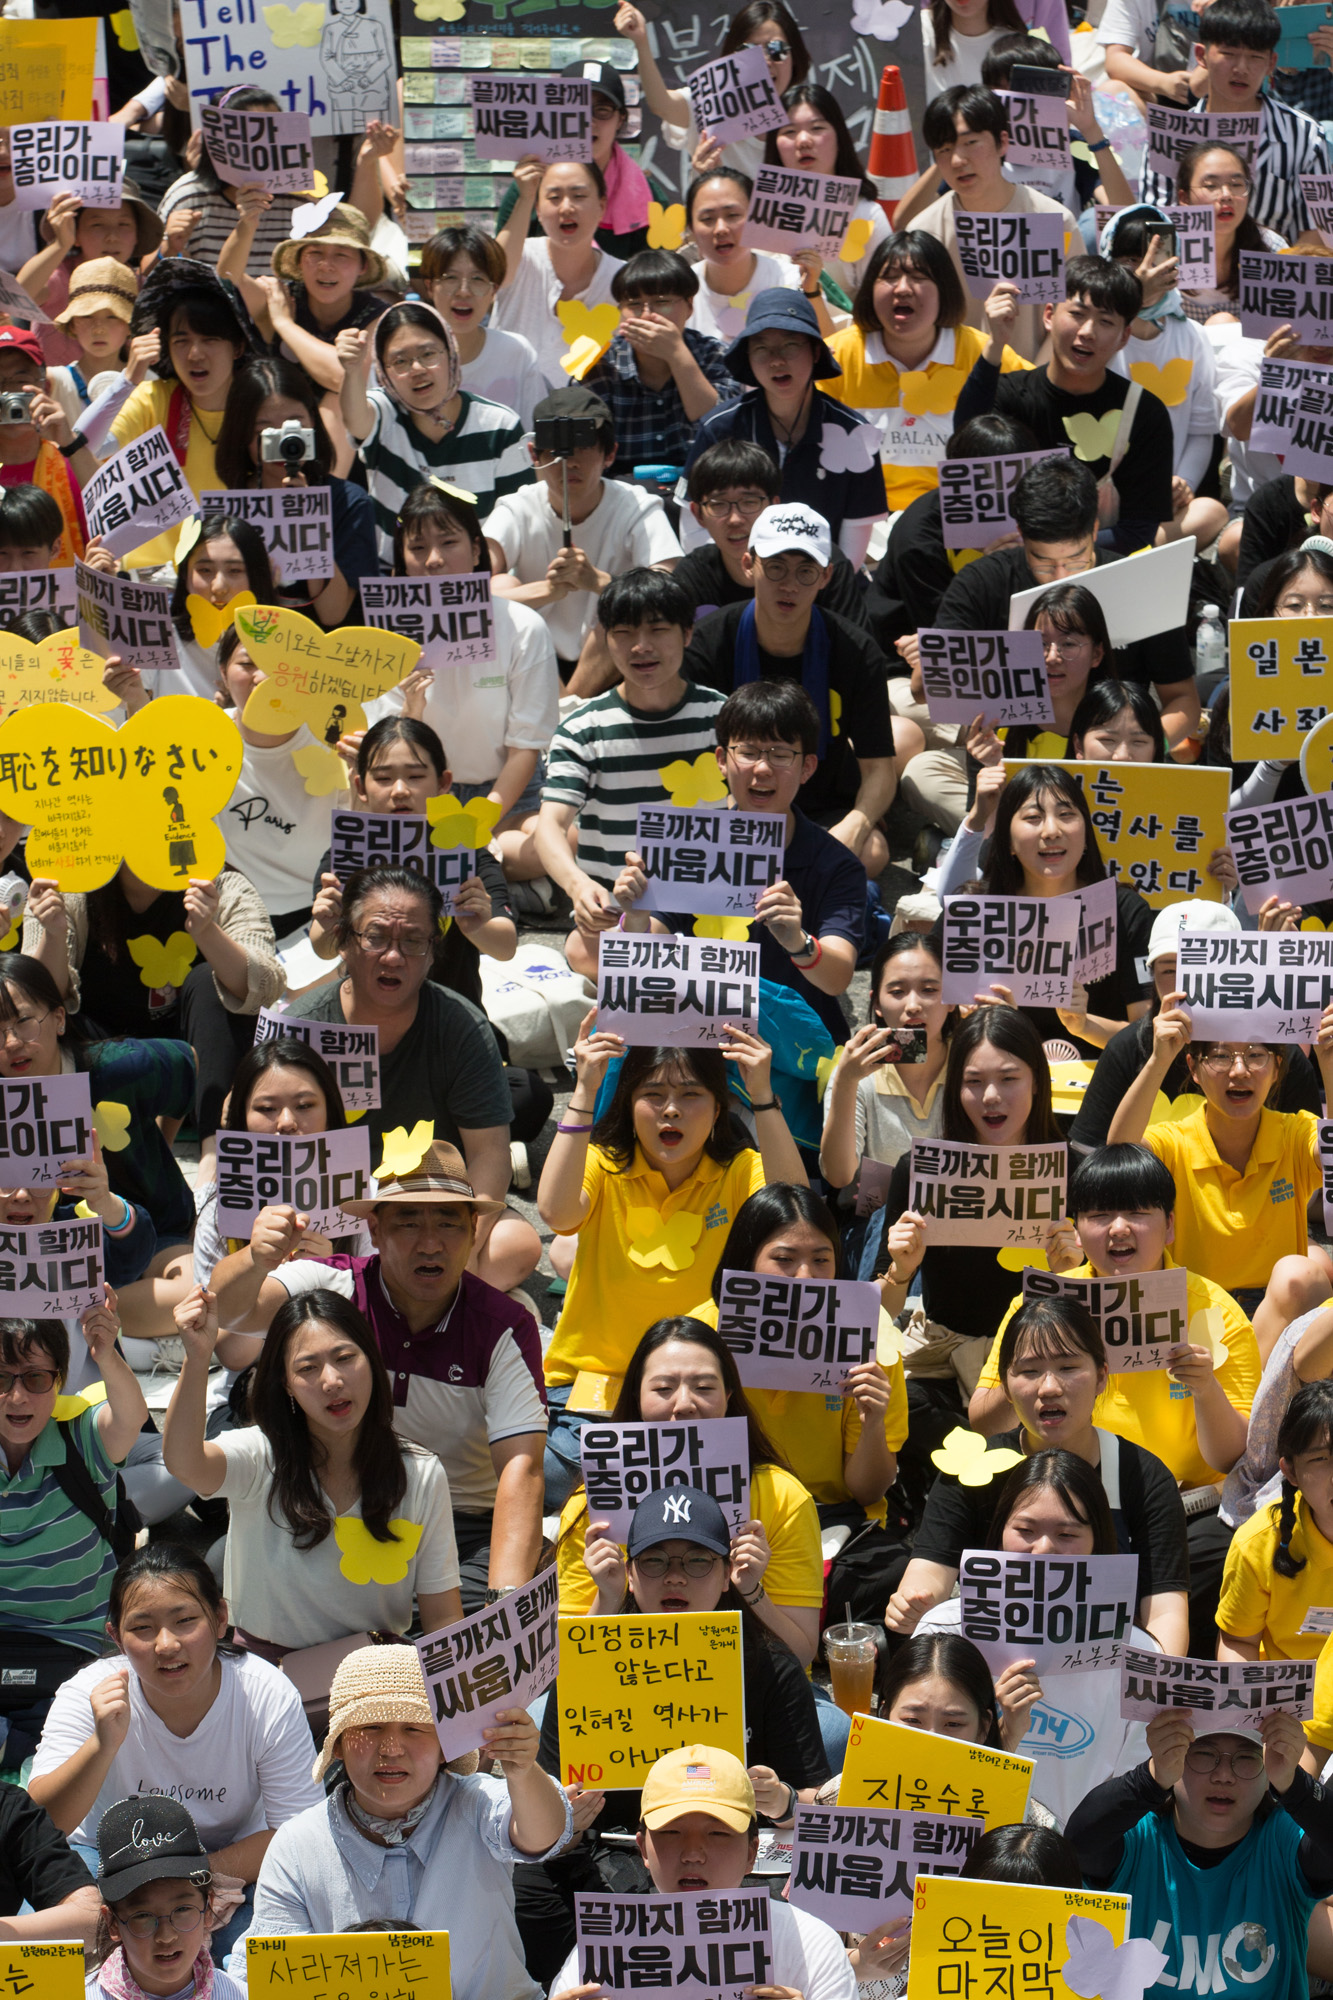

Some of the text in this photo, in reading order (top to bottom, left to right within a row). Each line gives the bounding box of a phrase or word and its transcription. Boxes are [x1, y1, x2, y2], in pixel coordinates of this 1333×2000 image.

[184, 0, 256, 29] Tell
[186, 34, 268, 76] The
[473, 81, 588, 105] 끝까지 함께
[690, 59, 740, 97] 우리가
[201, 108, 278, 144] 우리가
[475, 109, 589, 140] 싸웁시다
[1147, 108, 1260, 138] 끝까지 함께
[12, 126, 92, 157] 우리가
[207, 134, 311, 171] 증인이다
[14, 155, 121, 187] 증인이다
[757, 169, 859, 210] 끝까지 함께
[749, 199, 853, 239] 싸웁시다
[955, 216, 1030, 247] 우리가
[959, 247, 1064, 278] 증인이다
[1241, 257, 1307, 284] 끝까지
[83, 432, 170, 511] 끝까지 함께
[89, 461, 183, 537] 싸웁시다
[201, 491, 329, 519] 끝까지 함께
[285, 554, 332, 574] 김복동
[75, 562, 169, 614] 끝까지 함께
[362, 577, 490, 609] 끝까지 함께
[77, 595, 172, 649] 싸웁시다
[127, 652, 178, 668] 김복동
[326, 642, 406, 681] 그날까지
[445, 641, 495, 663] 김복동
[920, 632, 1010, 668] 우리가
[923, 664, 1048, 700] 증인이다
[1000, 699, 1052, 721] 김복동
[229, 796, 297, 836] Paris
[639, 811, 783, 849] 끝까지 함께
[164, 831, 197, 842] Evidence
[643, 843, 783, 888] 싸웁시다
[945, 900, 1049, 940] 우리가
[602, 939, 757, 978] 끝까지 함께
[945, 937, 1073, 977] 증인이다
[1180, 938, 1268, 967] 끝까지
[600, 975, 757, 1020] 싸웁시다
[1022, 979, 1072, 1004] 김복동
[320, 1029, 376, 1057] 함께
[218, 1136, 332, 1178] 우리가
[913, 1144, 1065, 1180] 끝까지 함께
[911, 1180, 1064, 1222] 싸웁시다
[1272, 1190, 1295, 1205] FESTA
[38, 1223, 101, 1256] 함께
[723, 1276, 842, 1324] 우리가
[718, 1314, 875, 1366] 증인이다
[1170, 1390, 1193, 1400] FESTA
[583, 1425, 704, 1470] 우리가
[662, 1494, 692, 1525] NY
[961, 1556, 1092, 1603] 우리가
[419, 1570, 559, 1678] 끝까지 함께
[566, 1621, 740, 1656] 인정하지 남원여고
[961, 1597, 1131, 1646] 증인이다
[709, 1638, 738, 1652] 은가비
[1060, 1644, 1122, 1670] 김복동
[434, 1607, 559, 1725] 싸웁시다
[613, 1658, 715, 1688] 않는다고
[1124, 1648, 1314, 1686] 끝까지 함께
[1124, 1675, 1313, 1712] 싸웁시다
[652, 1700, 730, 1731] 역사가
[566, 1762, 604, 1786] NO
[968, 1748, 1032, 1775] 남원여고 은가비
[861, 1774, 991, 1819] 지울수록
[125, 1818, 184, 1852] love
[798, 1811, 983, 1858] 끝까지 함께
[578, 1897, 769, 1938] 끝까지 함께
[1063, 1893, 1132, 1911] 남원여고 은가비
[20, 1945, 58, 1958] 남원여고
[247, 1933, 436, 1955] 은가비 남원여고
[936, 1914, 1055, 1961] 오늘이
[269, 1950, 430, 1985] 사라져가는
[582, 1940, 772, 1988] 싸웁시다
